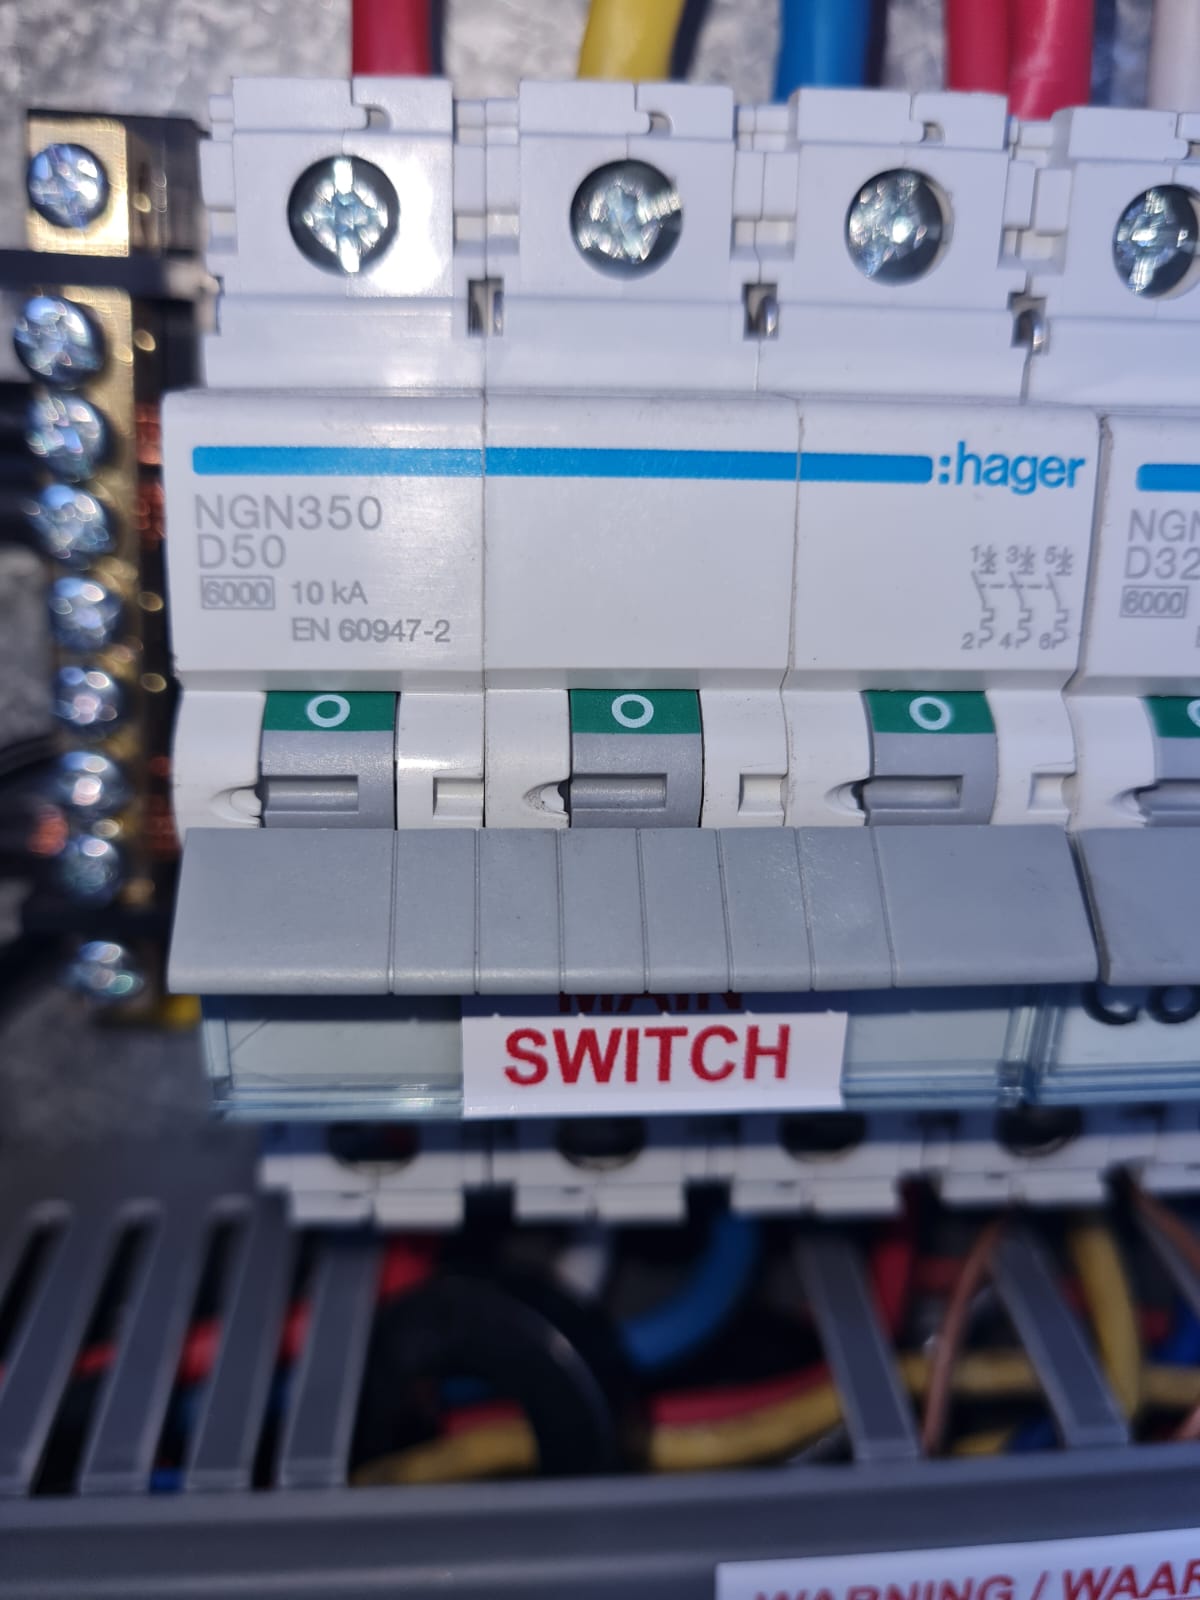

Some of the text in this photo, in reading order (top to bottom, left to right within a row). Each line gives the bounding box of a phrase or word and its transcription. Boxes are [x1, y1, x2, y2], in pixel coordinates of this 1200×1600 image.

[194, 493, 382, 530] NGN350
[197, 533, 286, 569] D50
[1123, 546, 1200, 579] D32
[204, 580, 368, 606] 6000 10 kA
[292, 617, 451, 643] EN 60947-2
[503, 1023, 791, 1086] SWITCH
